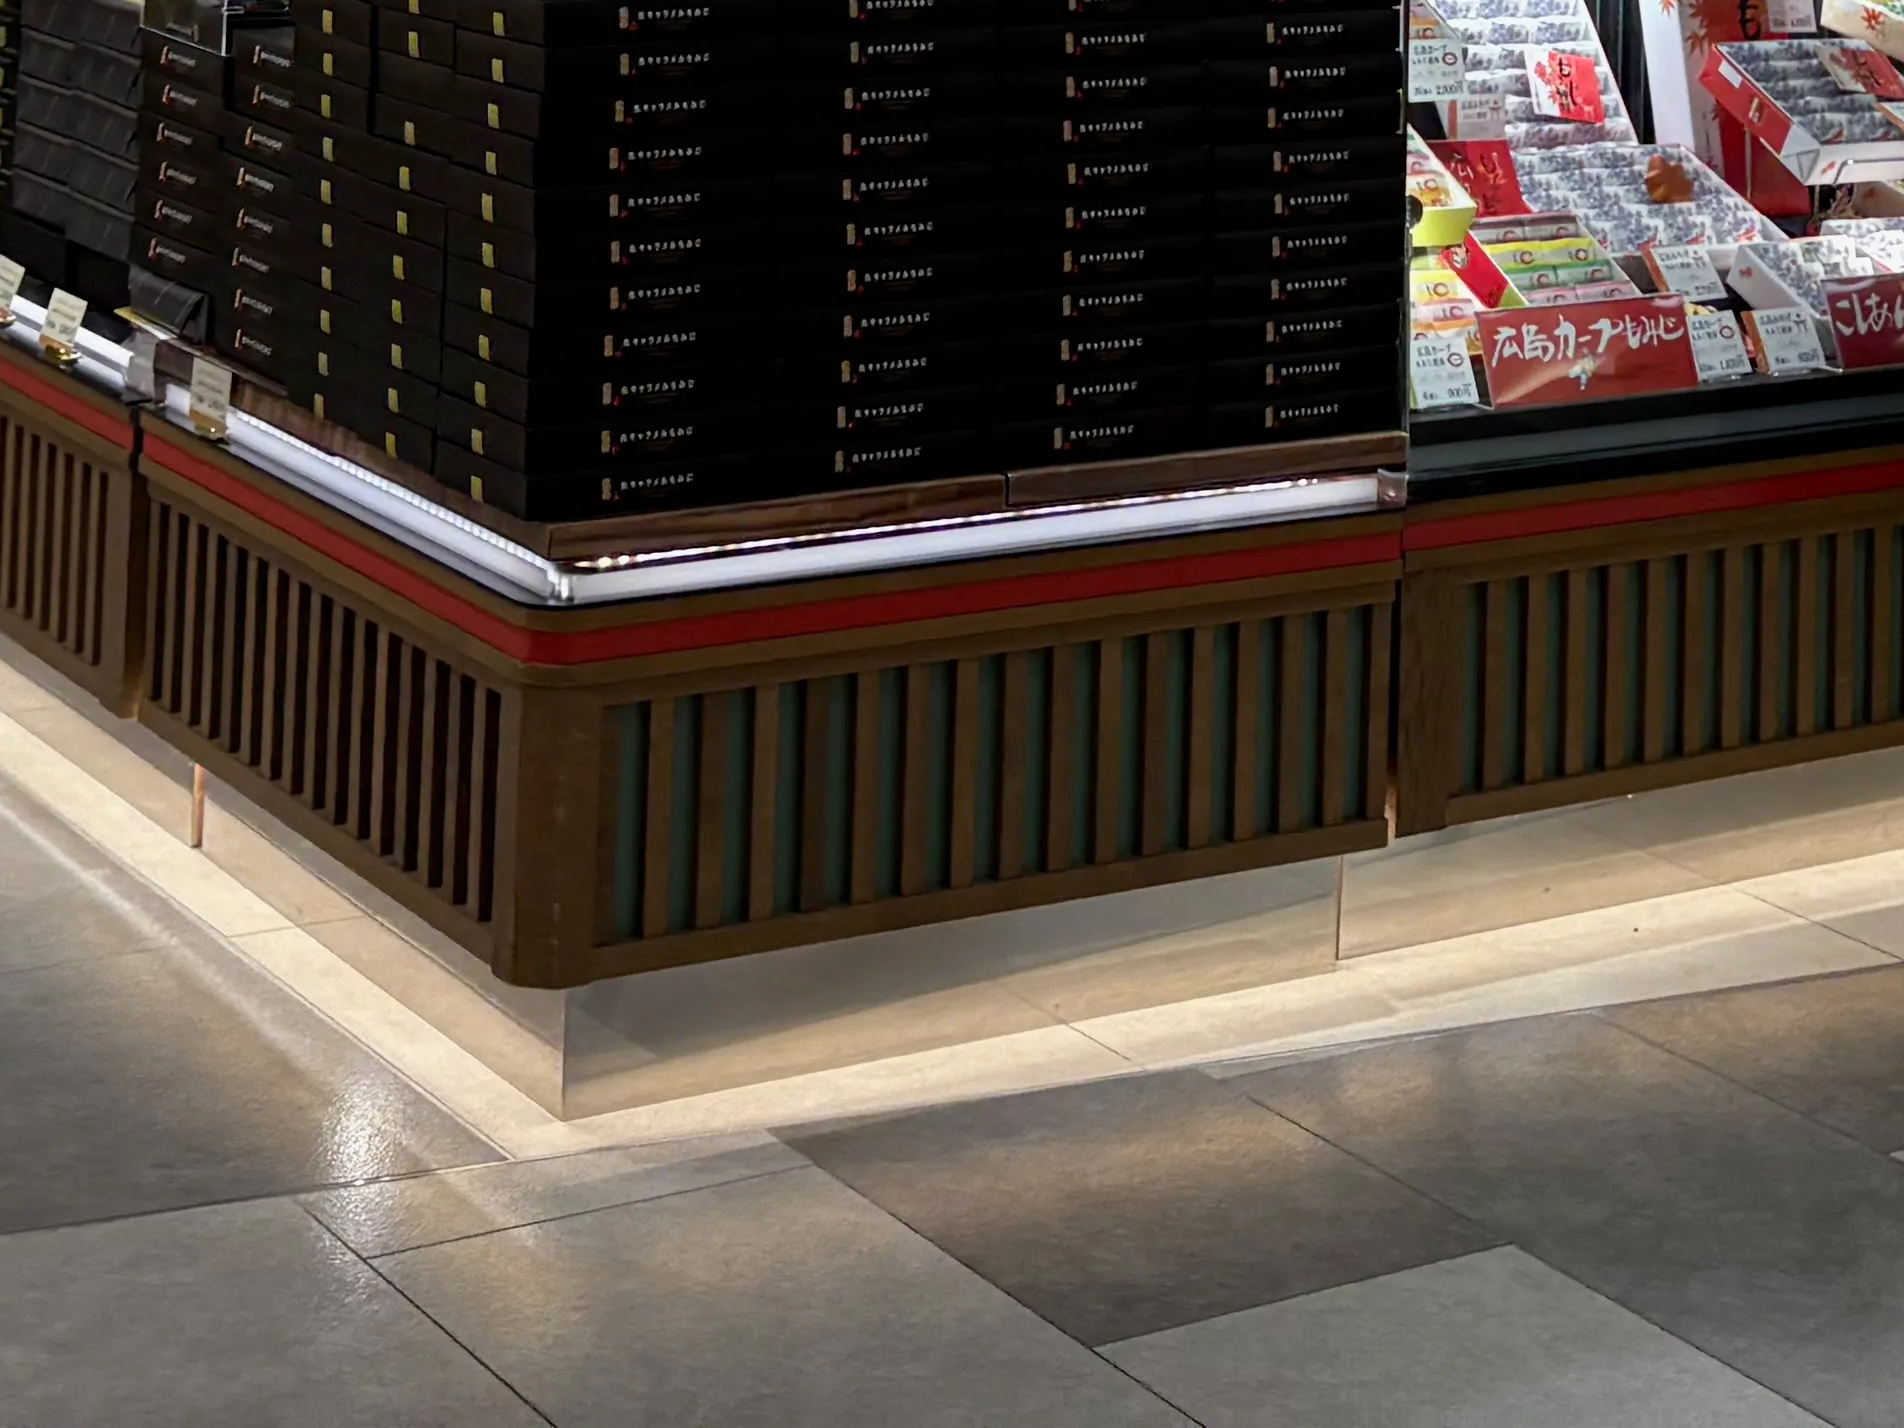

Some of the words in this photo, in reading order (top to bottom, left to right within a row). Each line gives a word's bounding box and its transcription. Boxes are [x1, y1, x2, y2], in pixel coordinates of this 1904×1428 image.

[1491, 313, 1685, 368] 広島カープもみじ
